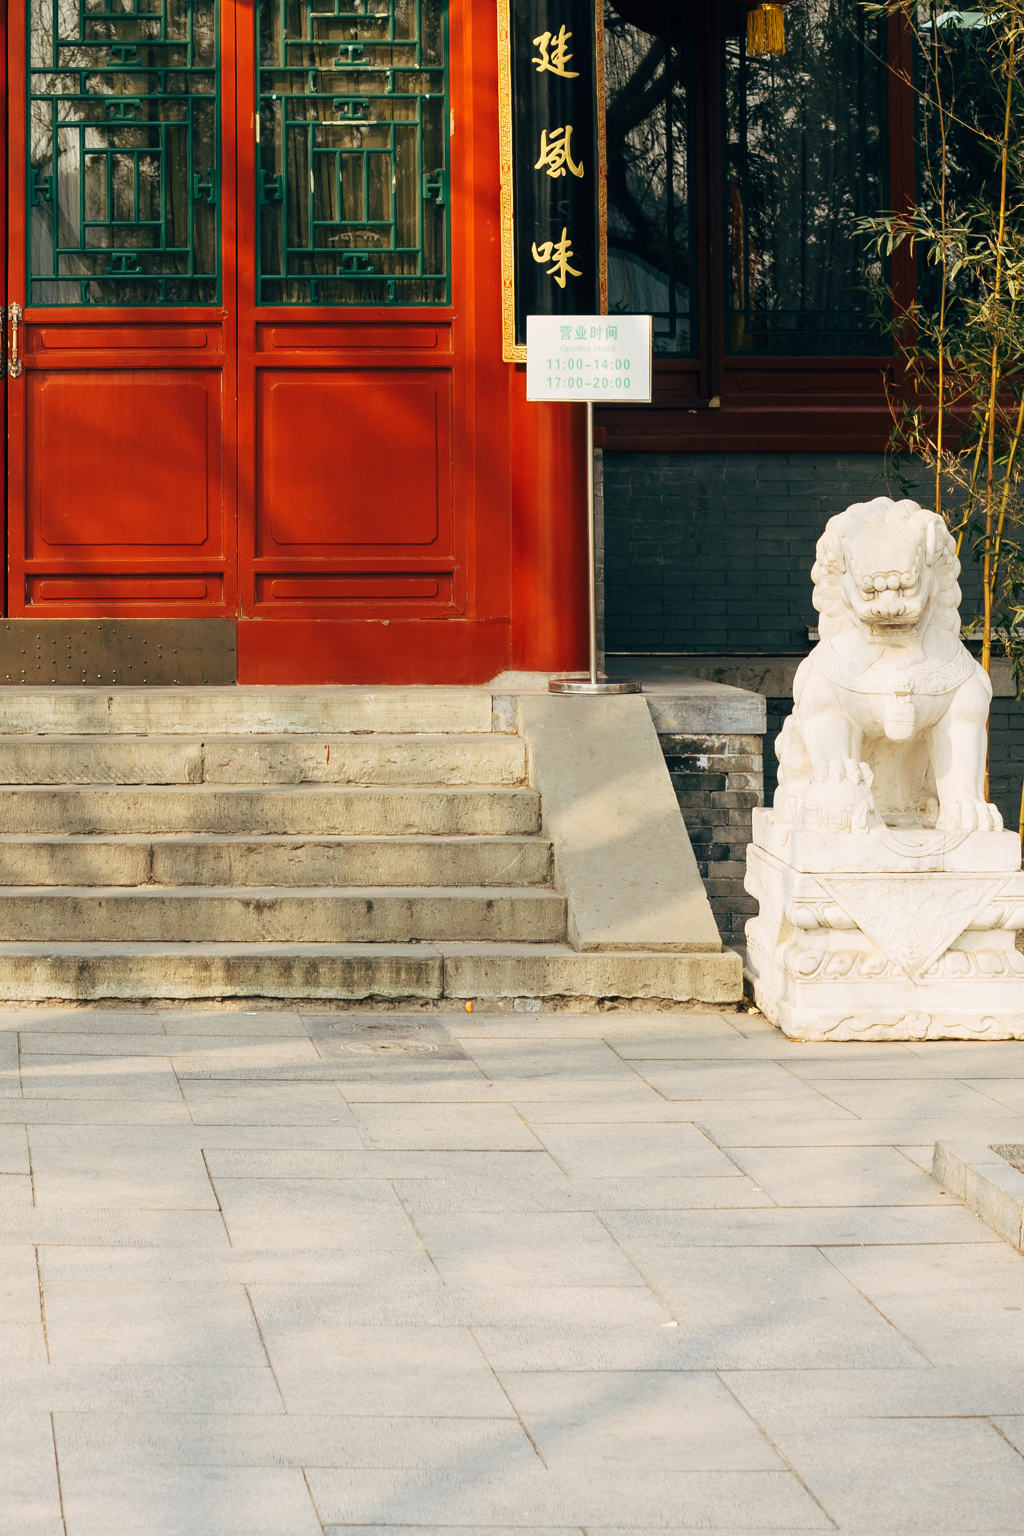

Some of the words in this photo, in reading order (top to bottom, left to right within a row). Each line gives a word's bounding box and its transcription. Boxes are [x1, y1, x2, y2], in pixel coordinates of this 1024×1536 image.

[559, 325, 618, 341] 营业时间
[560, 345, 591, 354] Opening
